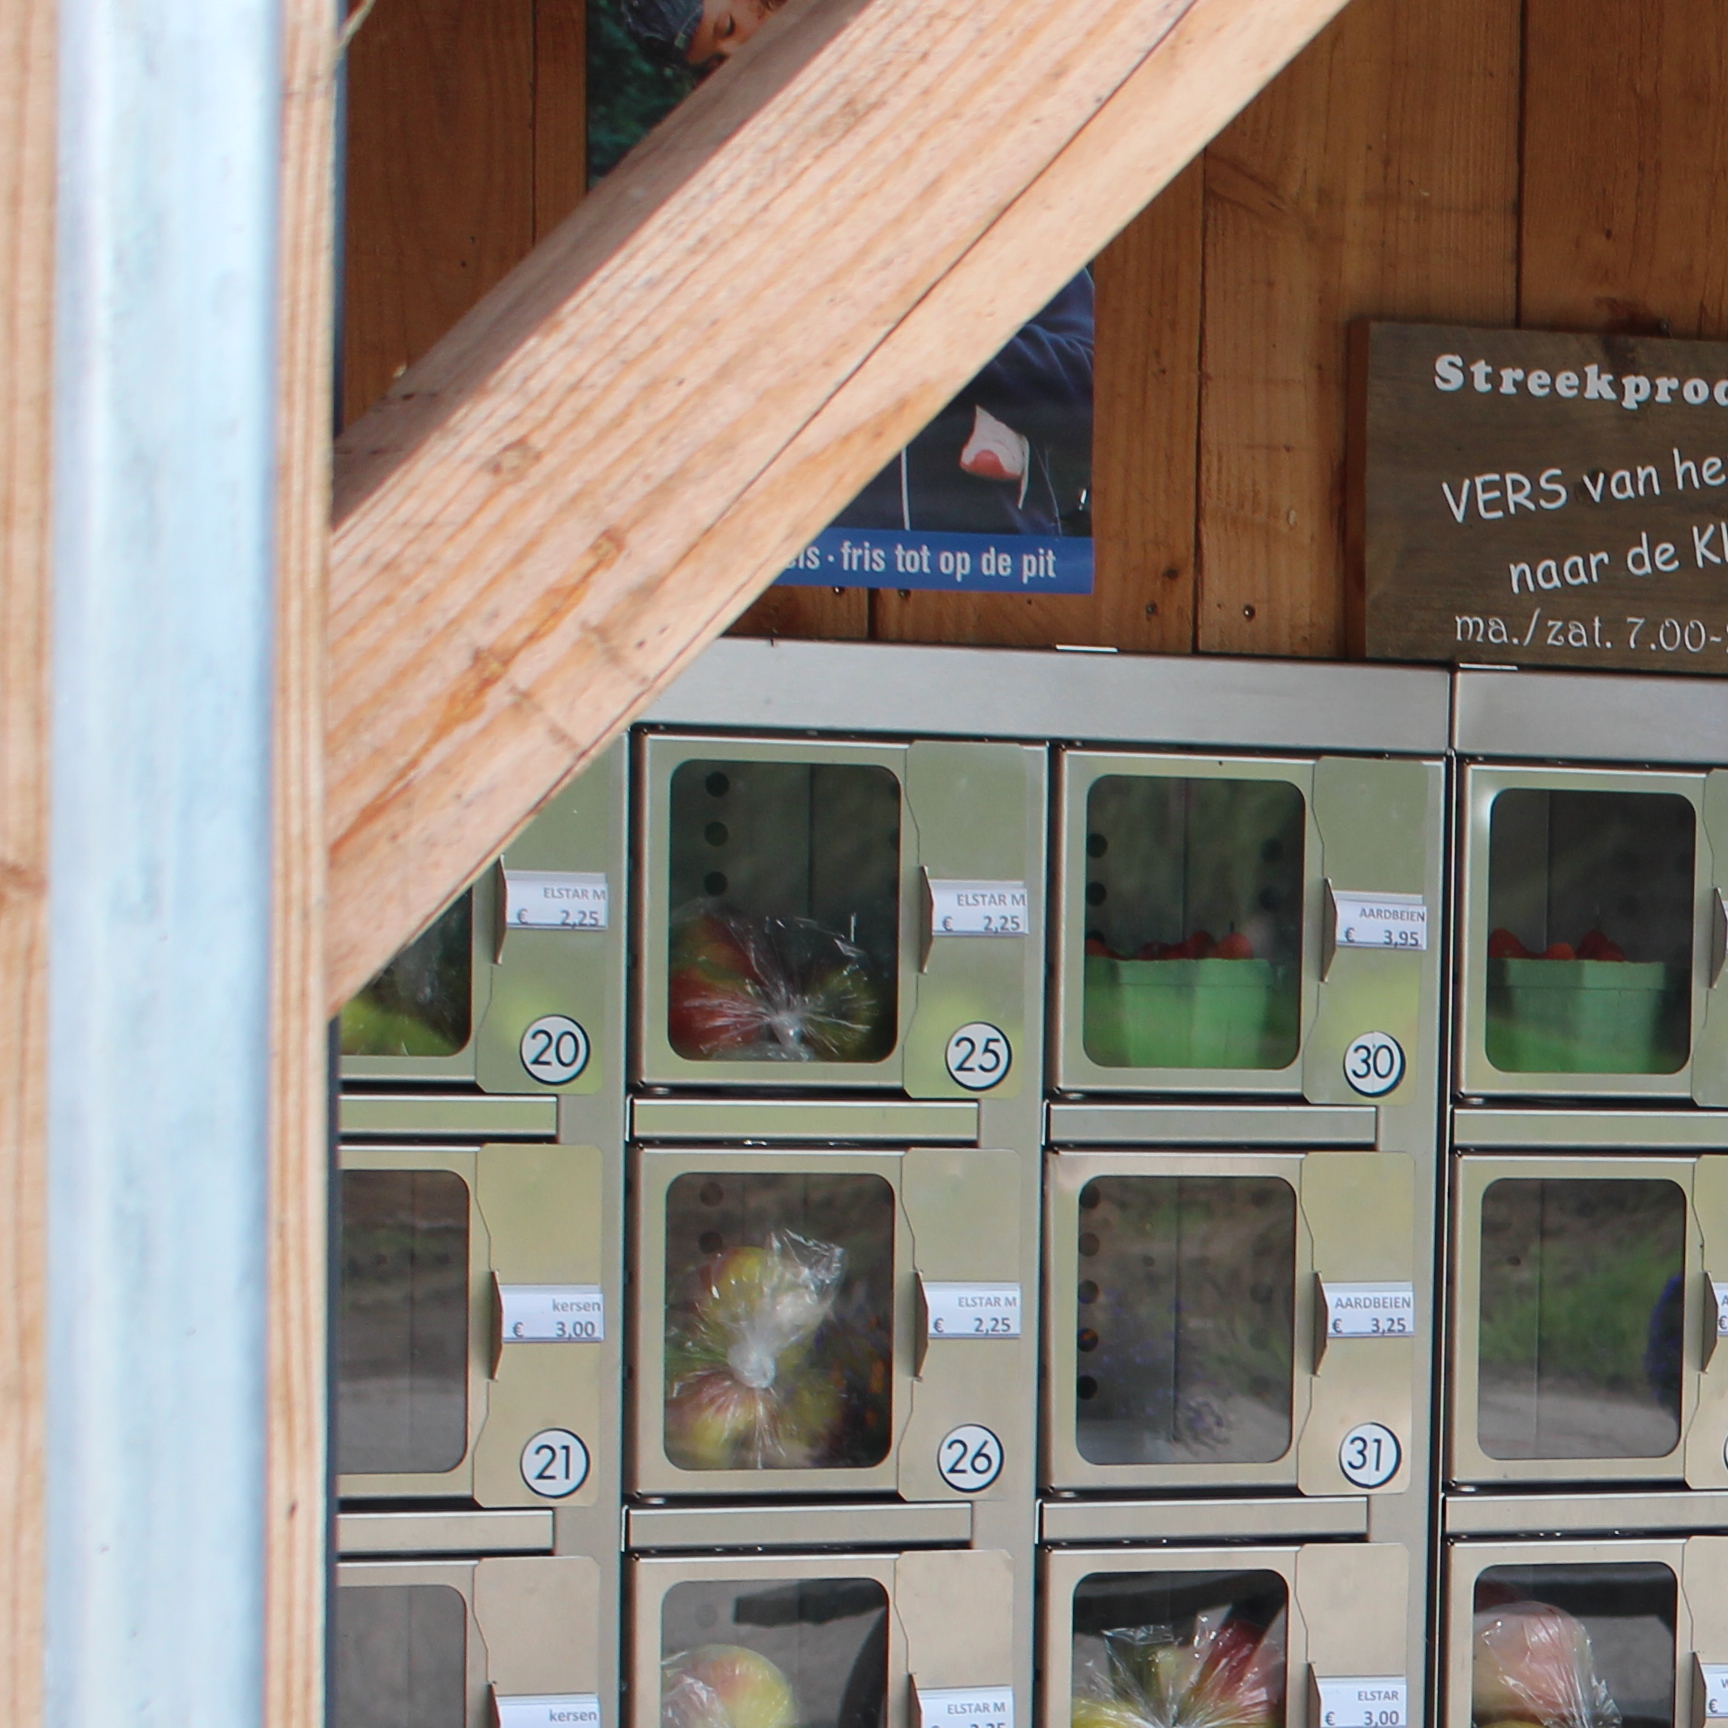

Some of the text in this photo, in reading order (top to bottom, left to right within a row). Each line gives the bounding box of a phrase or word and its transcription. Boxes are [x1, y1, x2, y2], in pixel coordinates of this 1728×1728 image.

[1441, 469, 1568, 524] VERS
[1583, 464, 1661, 504] van
[841, 541, 885, 572] fris
[896, 544, 931, 573] tot
[940, 550, 971, 582] op
[981, 547, 1012, 576] de
[1022, 548, 1056, 584] pit
[1509, 550, 1609, 594] naar
[1626, 533, 1680, 575] de
[543, 887, 606, 901] ELSTAR M
[516, 909, 599, 929] € 2,25
[531, 1030, 579, 1067] 20
[955, 1037, 1000, 1072] 25
[1352, 1045, 1394, 1078] 30
[552, 1299, 600, 1312] kersen
[1334, 1297, 1411, 1309] AARDBEIEN
[513, 1322, 595, 1340] € 3,00
[1332, 1318, 1406, 1335] € 3,25
[948, 1439, 992, 1474] 26
[1357, 1691, 1399, 1701] ELSTAR
[948, 1702, 1007, 1715] ELSTAR M
[1708, 1699, 1718, 1713] €
[1325, 1711, 1399, 1728] € 3,00
